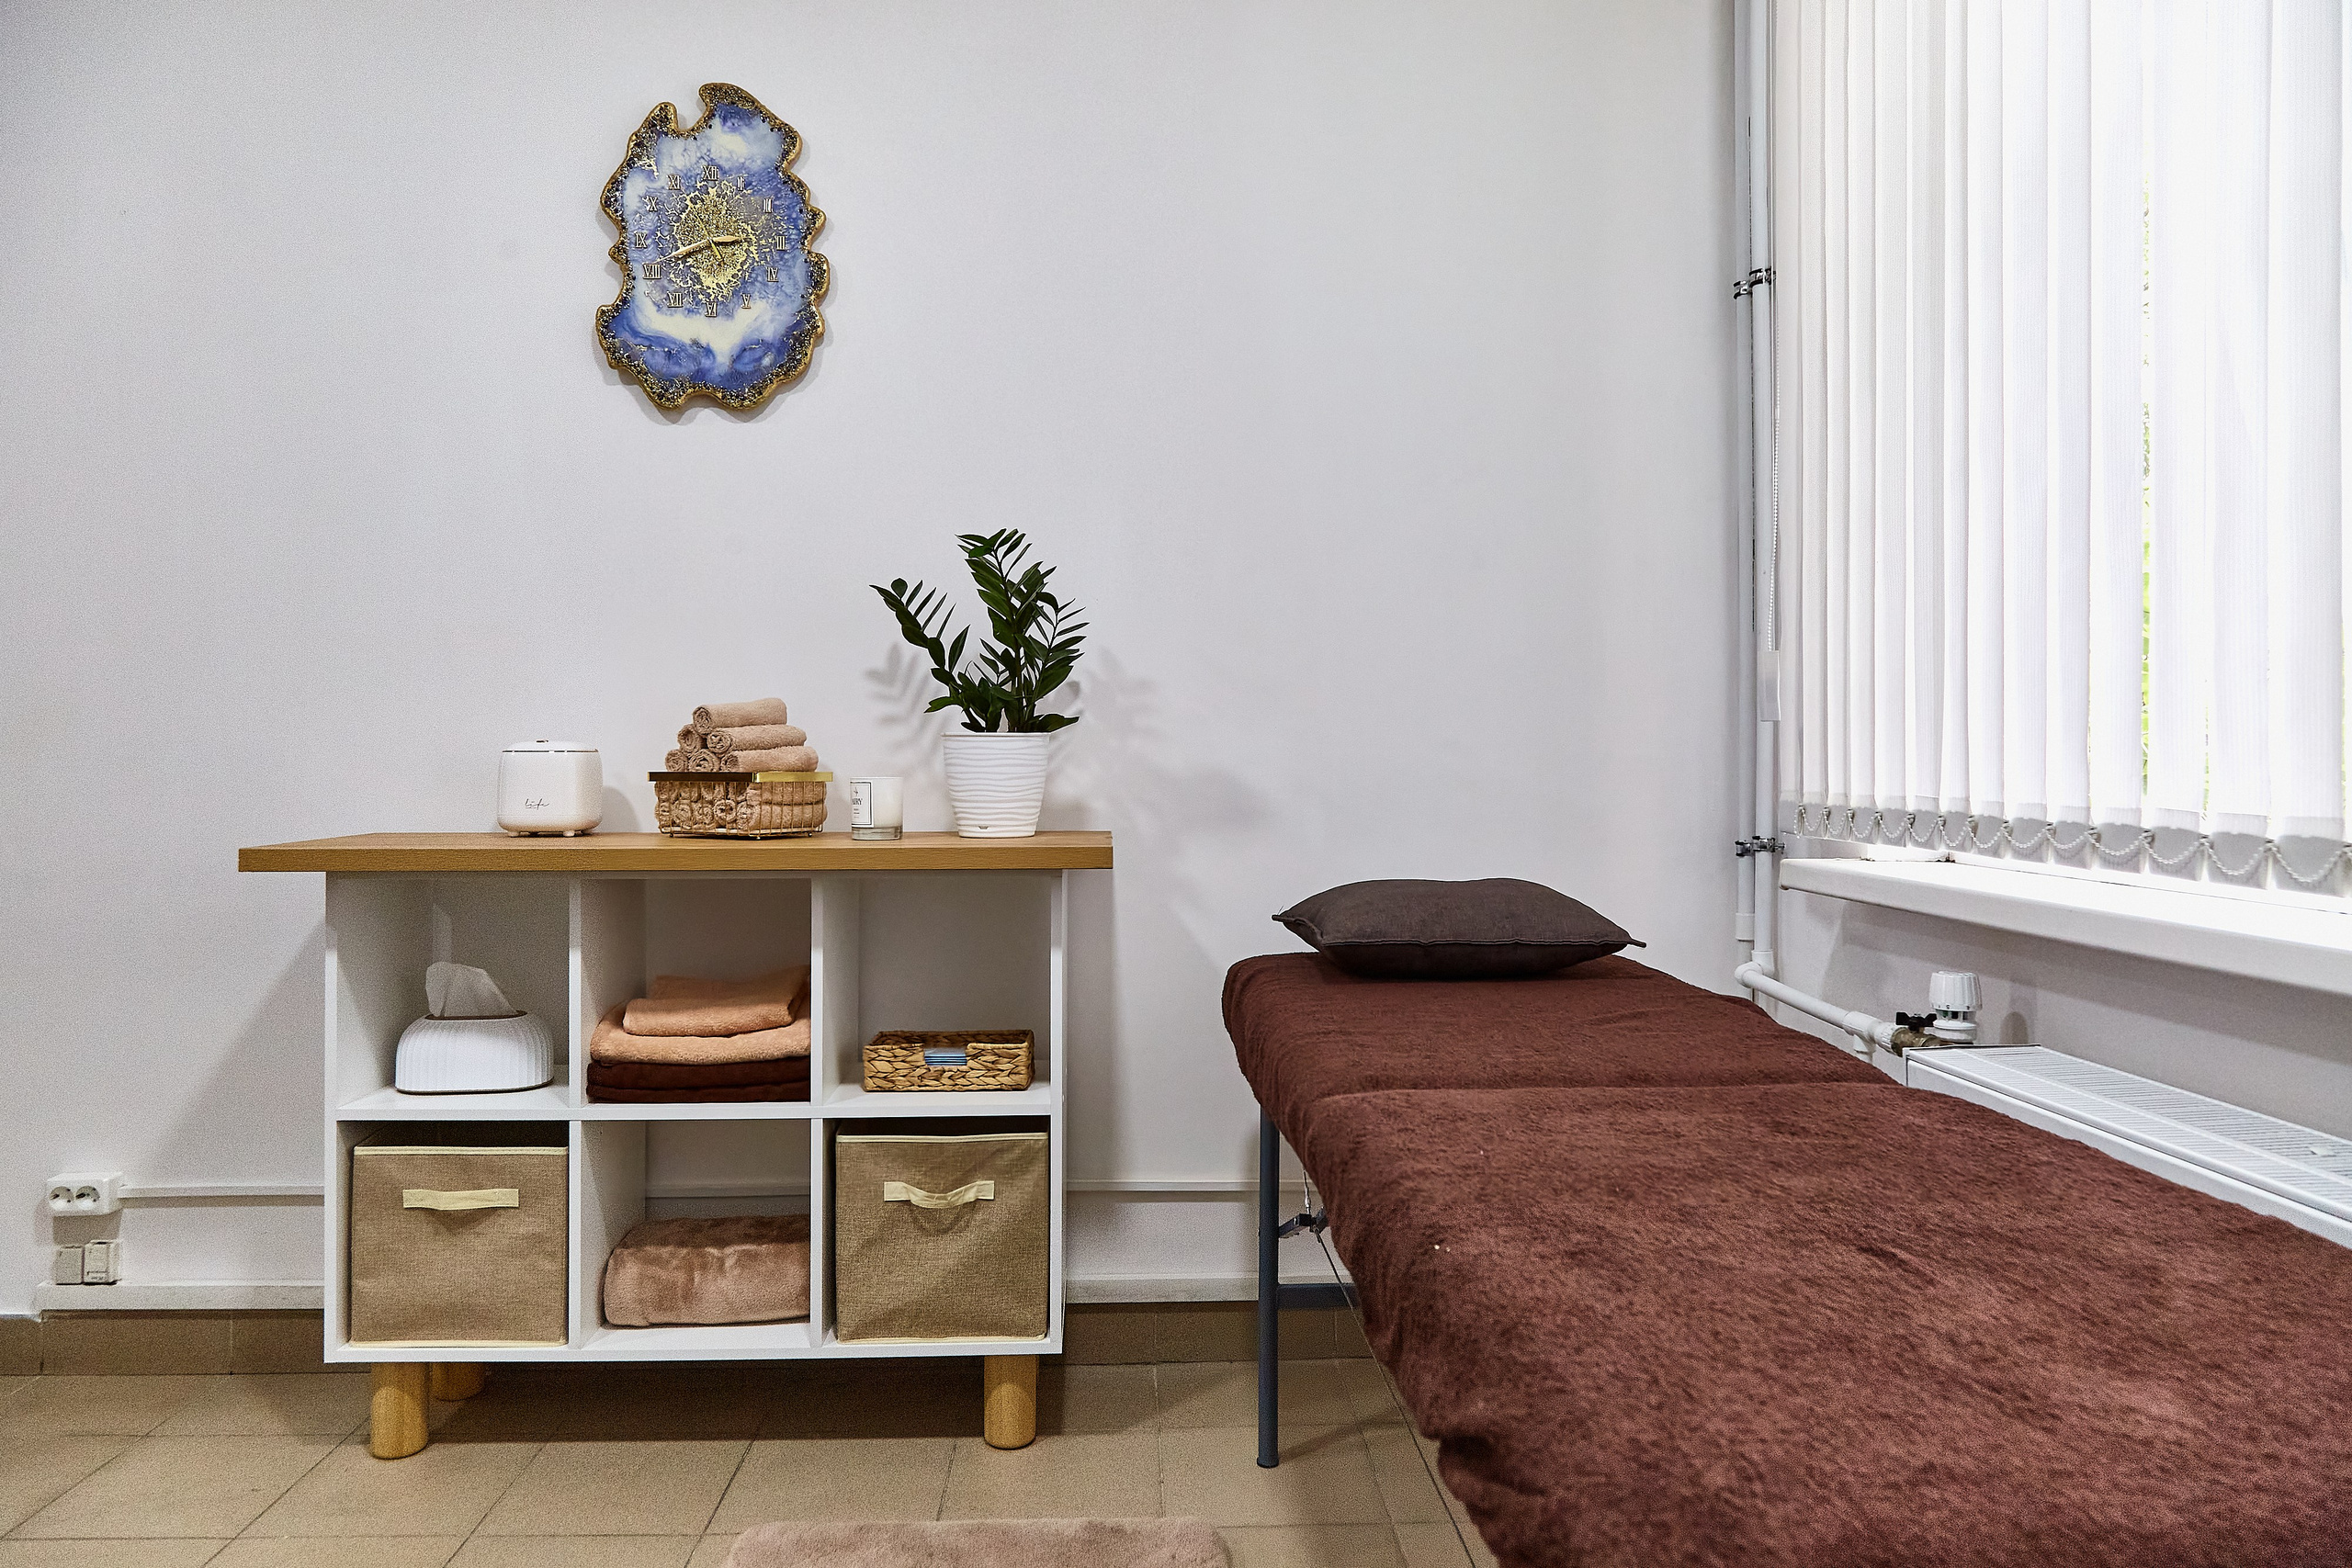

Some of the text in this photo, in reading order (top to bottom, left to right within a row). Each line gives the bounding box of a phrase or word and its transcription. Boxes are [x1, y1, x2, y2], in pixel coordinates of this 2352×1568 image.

[703, 165, 718, 181] XII
[669, 175, 681, 190] XI
[649, 197, 658, 212] X
[635, 232, 647, 247] IX
[775, 235, 786, 251] III
[643, 264, 661, 279] VIII
[667, 292, 682, 308] VII
[706, 302, 717, 317] VI
